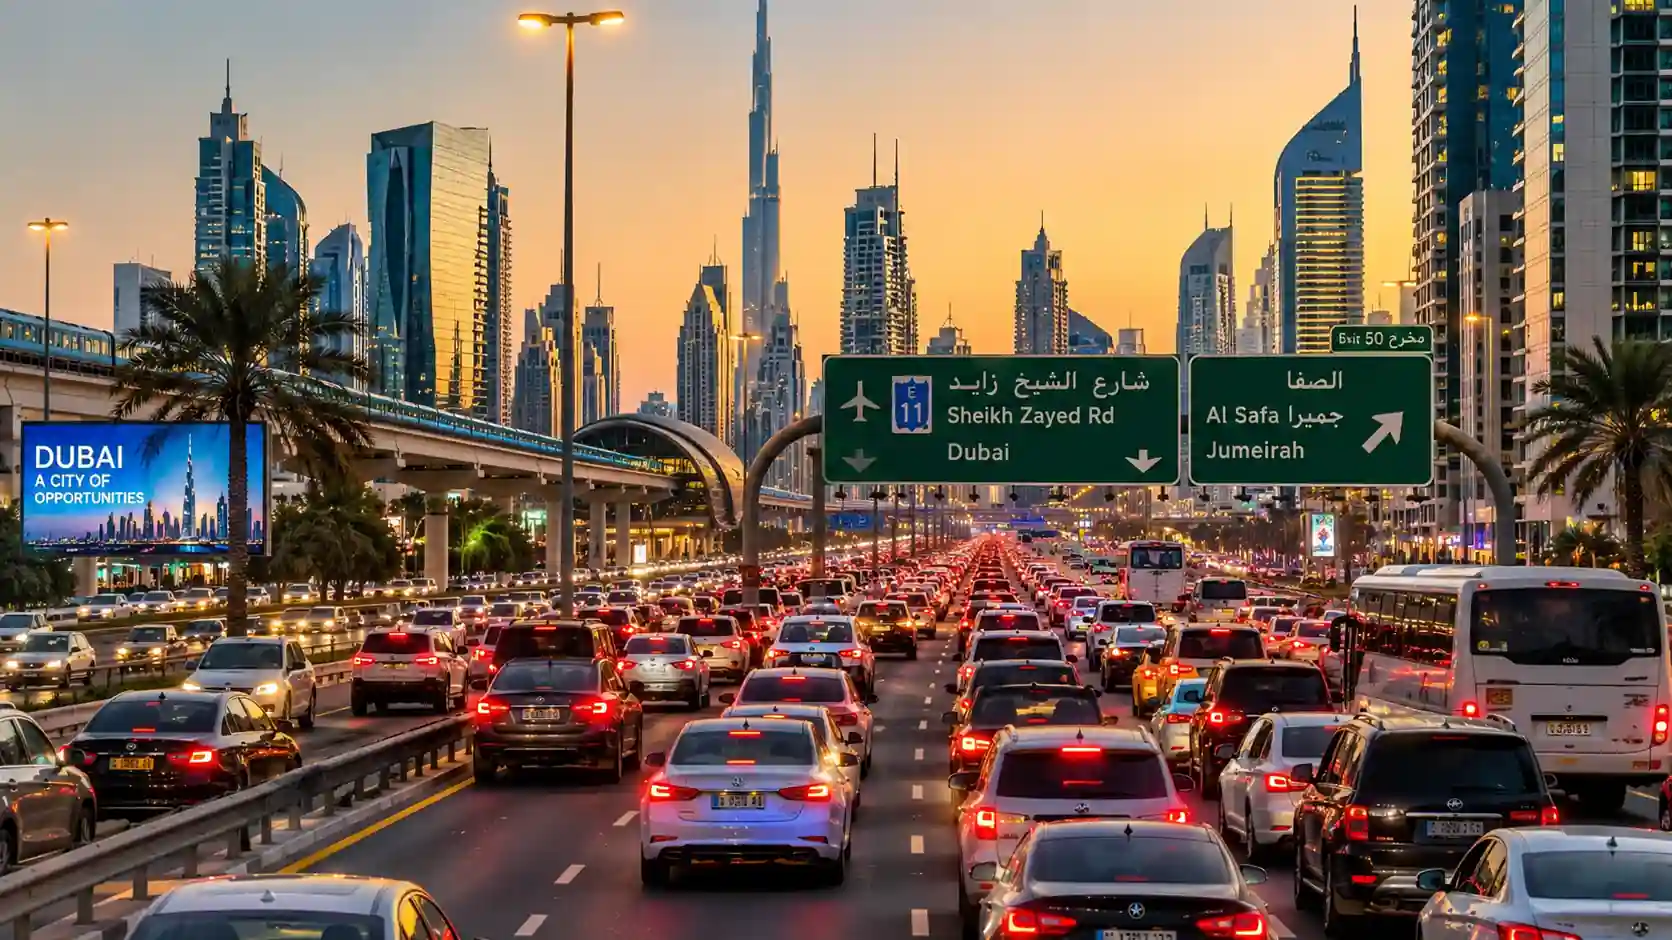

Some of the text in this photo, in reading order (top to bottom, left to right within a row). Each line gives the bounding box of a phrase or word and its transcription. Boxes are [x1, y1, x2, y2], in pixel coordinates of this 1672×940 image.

[1365, 331, 1384, 345] 50
[949, 370, 1150, 399] شارع الشيخ زايد
[1287, 370, 1343, 390] الصفا
[907, 386, 917, 399] E
[900, 402, 921, 423] 11
[947, 406, 1114, 429] Sheikh Zayed Rd
[1206, 405, 1280, 424] Al Safa
[1288, 404, 1344, 429] جميرا
[35, 445, 123, 469] DUBAI
[948, 442, 1009, 461] Dubai
[1206, 440, 1304, 459] Jumeirah
[35, 473, 111, 488] A CITY OF
[34, 491, 145, 505] OPPORTUNITIES
